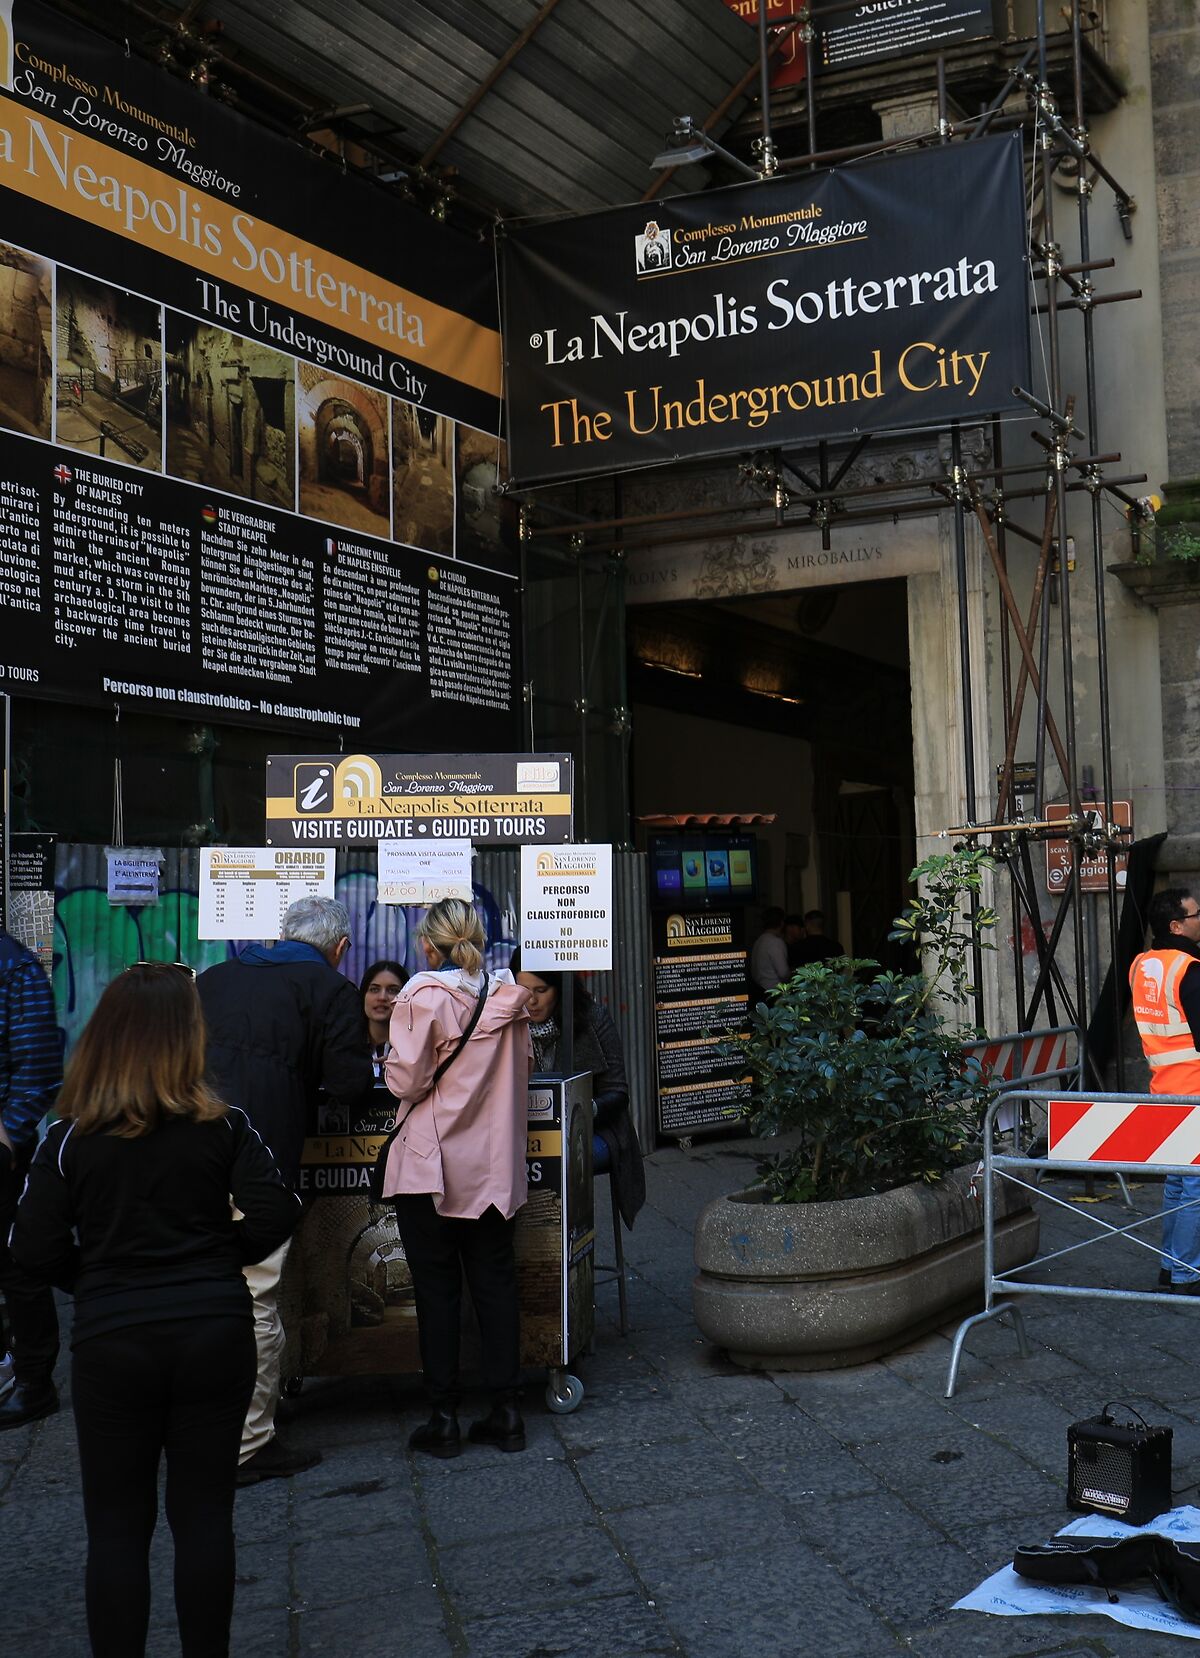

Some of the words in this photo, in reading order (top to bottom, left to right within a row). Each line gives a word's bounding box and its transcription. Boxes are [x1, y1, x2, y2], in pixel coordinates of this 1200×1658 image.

[15, 42, 98, 97] Complesso
[103, 84, 197, 149] Monumentale
[13, 69, 57, 109] San
[63, 95, 148, 152] Lorenzo
[157, 136, 241, 199] Maggiore
[24, 116, 223, 258] Neapolis
[232, 215, 426, 348] Sotterrata
[674, 221, 736, 245] Complesso
[741, 202, 823, 232] Monumentale
[675, 242, 706, 268] San
[711, 233, 780, 262] Lorenzo
[786, 216, 868, 247] Maggiore
[591, 293, 758, 359] Neapolis
[766, 255, 998, 331] Sotterrata
[196, 277, 241, 324] The
[247, 300, 383, 382] Underground
[389, 361, 428, 403] City
[541, 397, 613, 448] The
[624, 350, 885, 430] Underground
[898, 341, 991, 397] City
[75, 468, 91, 482] THE
[93, 473, 123, 491] BURIED
[125, 482, 143, 496] CITY
[76, 484, 87, 495] OF
[89, 487, 122, 505] NAPLES
[54, 492, 65, 507] By
[75, 499, 129, 523] descending
[137, 515, 151, 527] ten
[160, 521, 190, 537] meters
[218, 507, 230, 521] DIE
[232, 511, 276, 533] VERGRABENE
[53, 508, 118, 534] underground,
[120, 523, 128, 534] it
[131, 525, 139, 537] is
[142, 529, 179, 548] possible
[181, 537, 190, 550] to
[53, 522, 87, 538] admire
[88, 528, 103, 542] the
[105, 533, 129, 548] ruins
[130, 539, 140, 551] of
[218, 521, 240, 537] STADT
[242, 528, 267, 544] NEAPEL
[53, 536, 75, 550] with
[88, 542, 103, 556] the
[116, 550, 150, 567] ancient
[161, 560, 190, 576] Roman
[338, 554, 349, 566] DE
[350, 556, 370, 572] NAPLES
[372, 562, 401, 579] ENSEVELIE
[372, 550, 389, 563] VILLE
[54, 550, 92, 568] market,
[94, 558, 122, 574] which
[124, 566, 142, 578] was
[144, 570, 178, 587] covered
[180, 577, 190, 591] by
[55, 633, 77, 648] city.
[8, 666, 39, 682] TOURS
[103, 677, 153, 698] Percorso
[155, 687, 176, 700] non
[177, 689, 251, 711] claustrofobico
[260, 700, 272, 715] No
[274, 704, 342, 725] claustrophobic
[343, 714, 360, 728] tour
[395, 772, 433, 781] Complesso
[435, 771, 481, 780] Monumentale
[384, 782, 402, 793] San
[405, 782, 445, 793] Lorenzo
[448, 781, 493, 794] Maggiore
[378, 798, 450, 817] Neapolis
[454, 796, 544, 814] Sotterrata
[292, 820, 342, 838] VISITE
[346, 819, 413, 838] GUIDATE
[432, 818, 492, 836] GUIDED
[494, 817, 545, 836] TOURS
[275, 852, 325, 864] ORARIO
[543, 885, 590, 895] PERCORSO
[558, 898, 575, 907] NON
[527, 910, 606, 920] CLAUSTROFOBICO
[560, 927, 572, 936] NO
[686, 926, 731, 936] MAGGIORE
[525, 939, 608, 949] CLAUSTROPHOBIC
[555, 952, 579, 961] TOUR
[369, 1107, 397, 1118] Compl
[354, 1119, 376, 1133] San
[315, 1167, 375, 1189] GUIDAT
